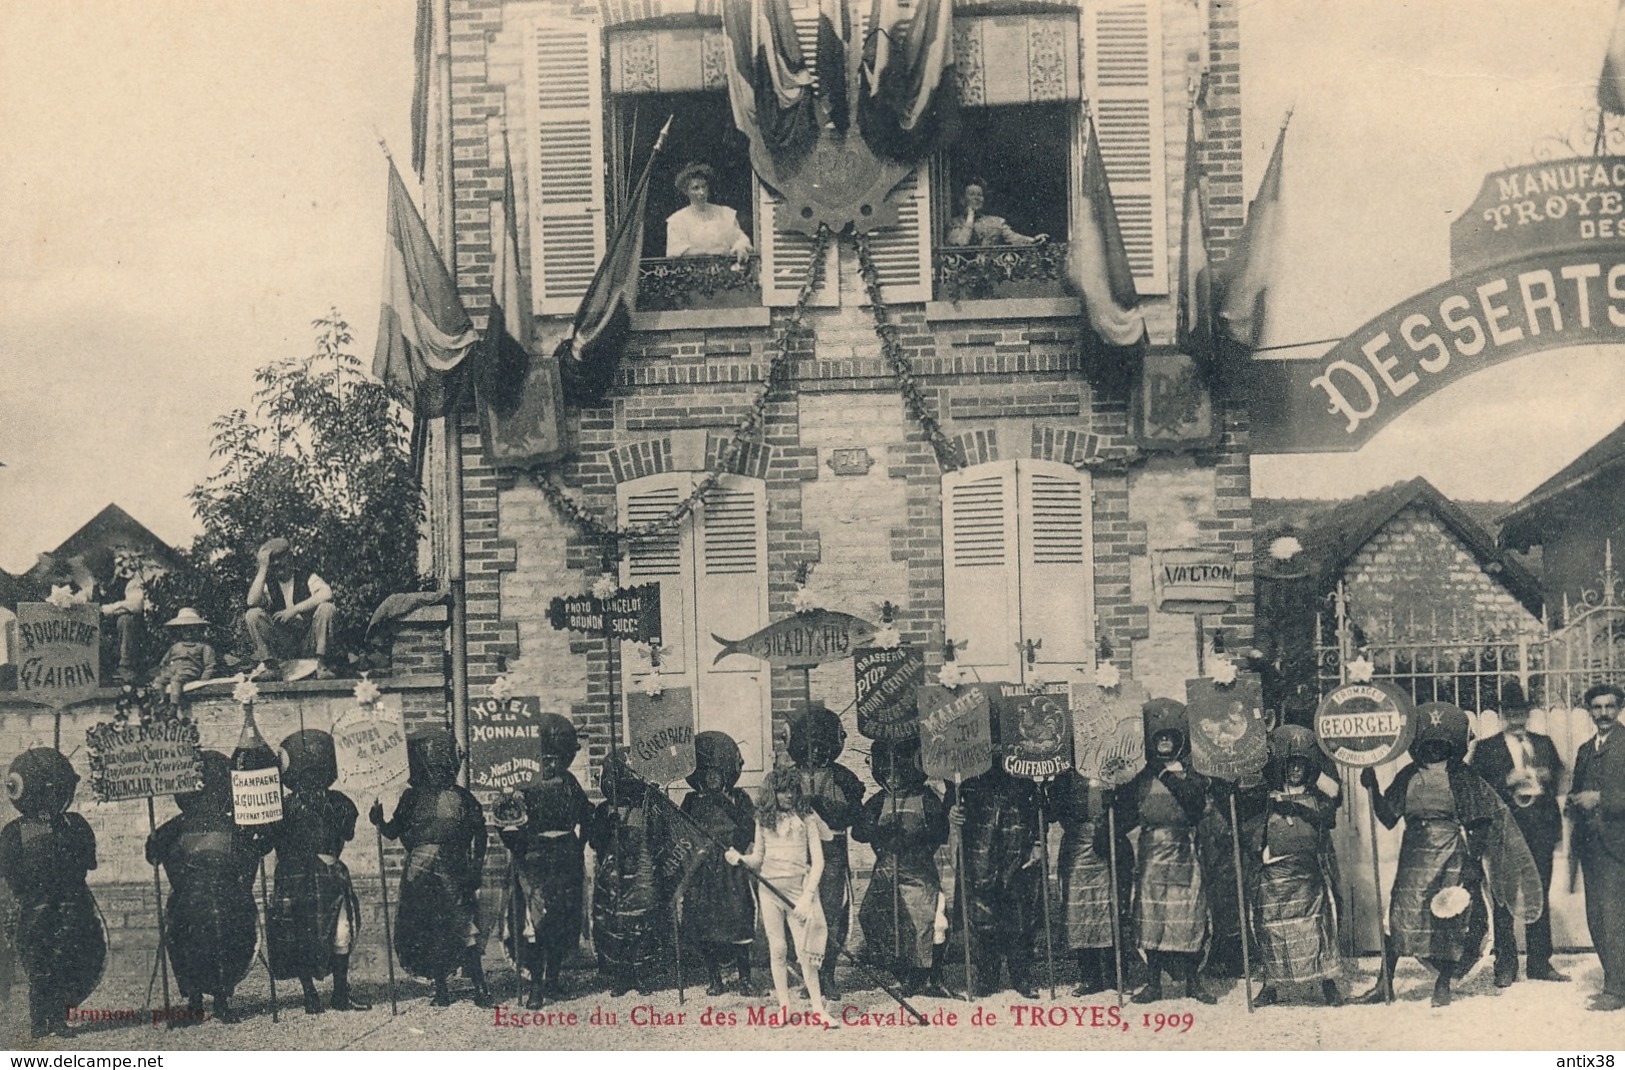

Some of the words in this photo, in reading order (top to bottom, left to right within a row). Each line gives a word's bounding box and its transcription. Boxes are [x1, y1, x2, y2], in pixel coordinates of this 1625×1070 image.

[1496, 164, 1625, 202] MANUFAC
[1310, 263, 1625, 434] DESSERTS
[565, 601, 591, 613] PHOTO
[570, 614, 603, 630] BRUNON
[19, 619, 98, 652] BOUCHERIE
[856, 647, 907, 672] BRASSERIE
[856, 665, 887, 702] PIOT
[859, 689, 887, 718] POINT
[881, 656, 923, 694] CENTRAL
[471, 700, 532, 720] HOTEL
[472, 725, 540, 743] MONNAIE
[1321, 715, 1399, 736] GEORGEL
[637, 726, 692, 761] GUERRIER
[1004, 755, 1055, 776] GOIFFARD
[233, 774, 279, 788] CHAMPAGNE
[480, 771, 533, 787] BANQUETS
